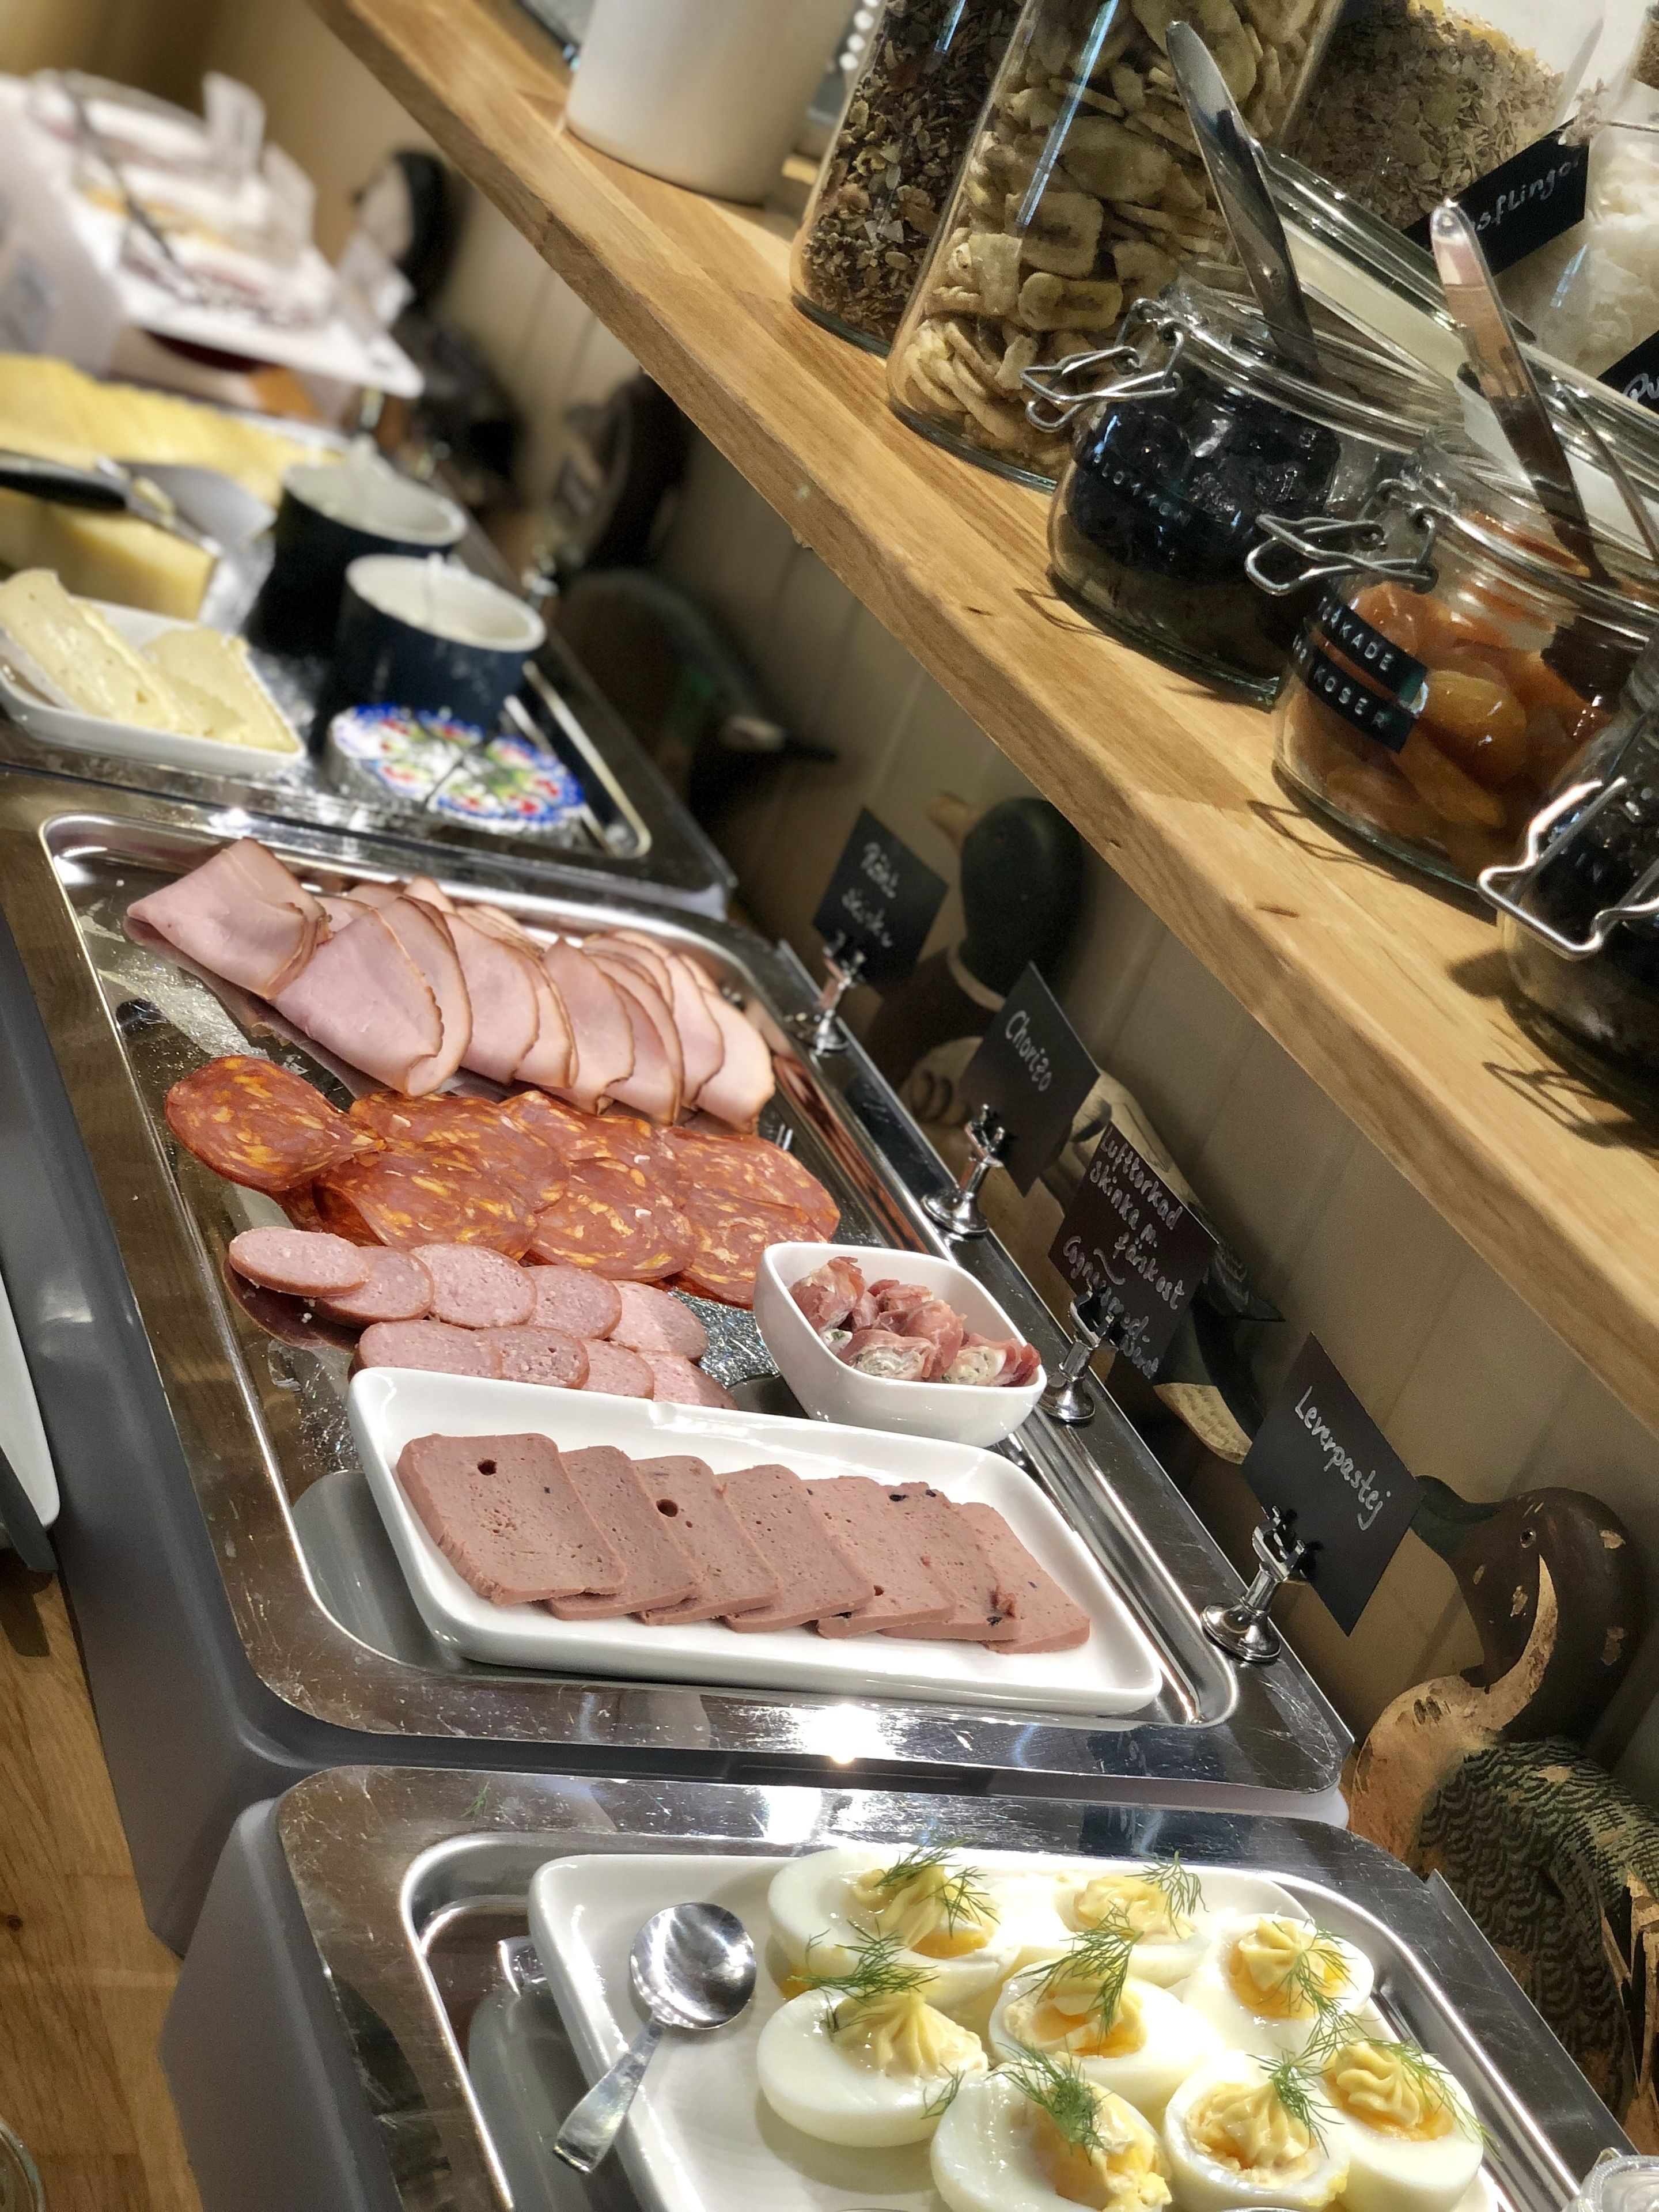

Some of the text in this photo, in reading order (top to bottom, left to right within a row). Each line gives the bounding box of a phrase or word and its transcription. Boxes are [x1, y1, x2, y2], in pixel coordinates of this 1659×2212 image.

[1005, 1010, 1052, 1092] Chorizo
[1100, 1127, 1183, 1230] Lufttorkad
[1295, 1385, 1391, 1531] Leverpastej
